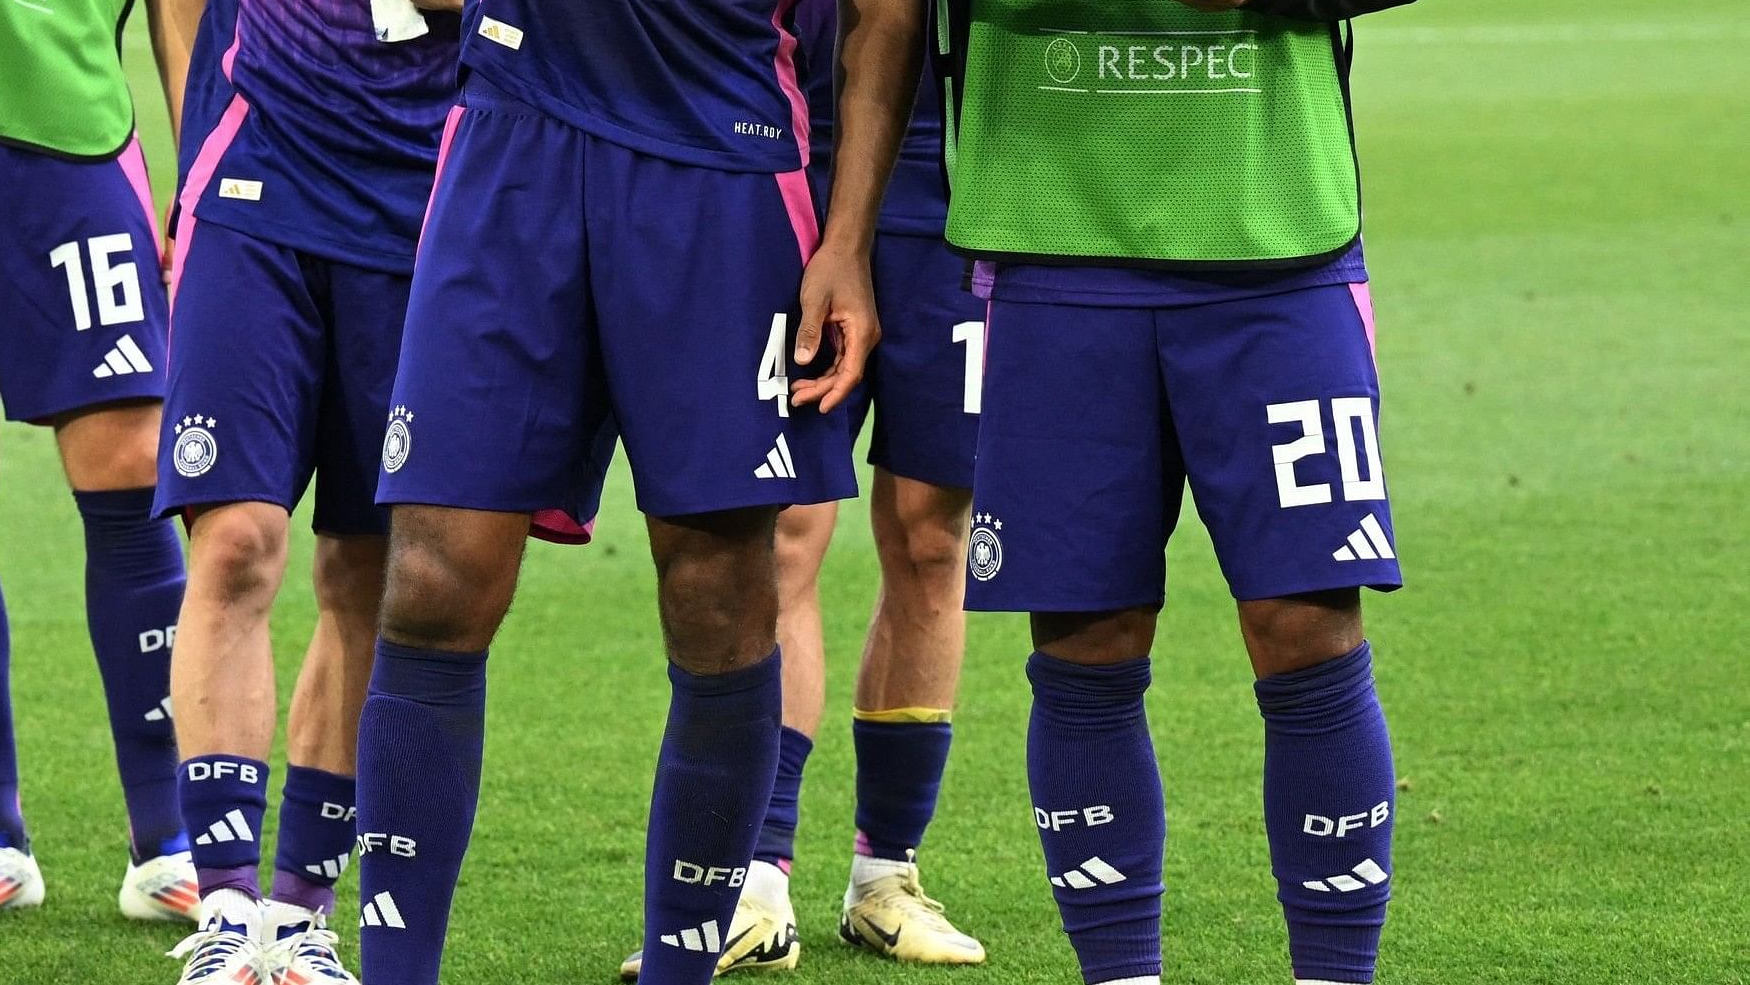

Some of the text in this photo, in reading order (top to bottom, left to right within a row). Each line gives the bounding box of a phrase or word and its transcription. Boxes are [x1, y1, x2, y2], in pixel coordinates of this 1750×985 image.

[734, 121, 783, 140] HEAT.RDY
[49, 232, 145, 332] 16
[757, 313, 790, 418] 4
[1266, 397, 1386, 508] 20
[187, 761, 258, 785] DFB
[1034, 804, 1115, 832] DFB
[1303, 800, 1390, 838] DFB
[673, 859, 747, 888] DFB
